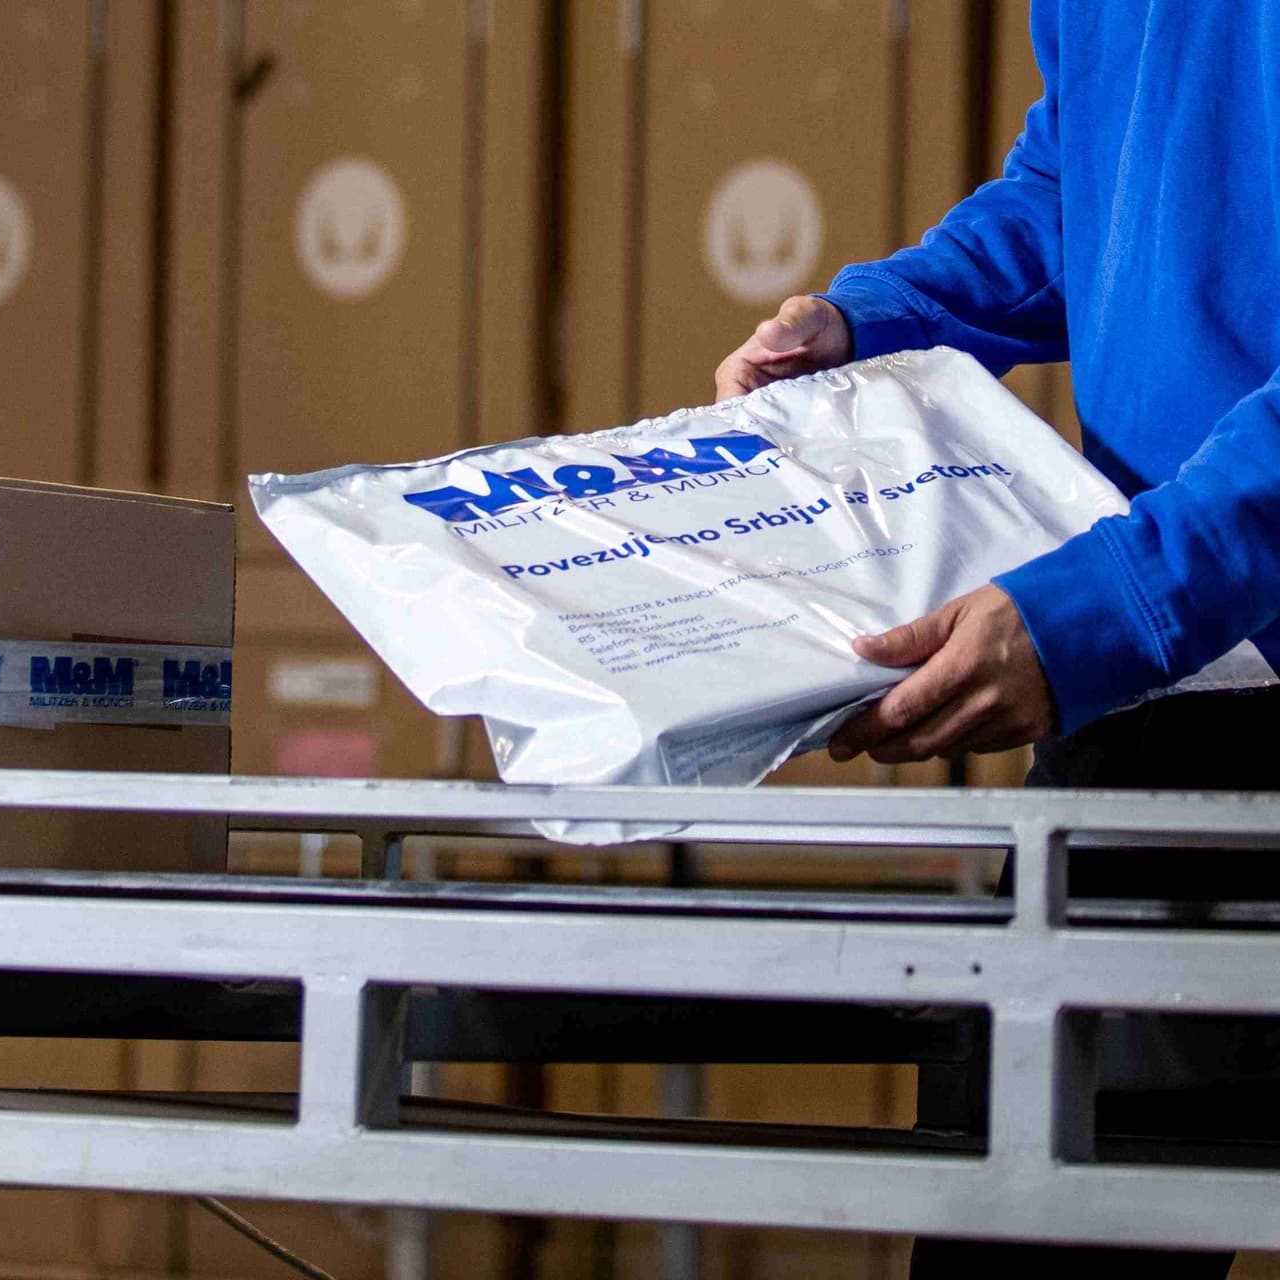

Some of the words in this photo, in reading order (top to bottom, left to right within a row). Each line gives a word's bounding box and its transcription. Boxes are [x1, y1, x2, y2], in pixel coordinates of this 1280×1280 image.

[403, 429, 781, 522] M&M
[627, 490, 654, 502] &
[500, 529, 721, 580] Povezujemo
[723, 497, 832, 534] Srbiju
[878, 462, 1012, 501] svetom!
[30, 655, 135, 695] M&M
[163, 658, 232, 699] M&
